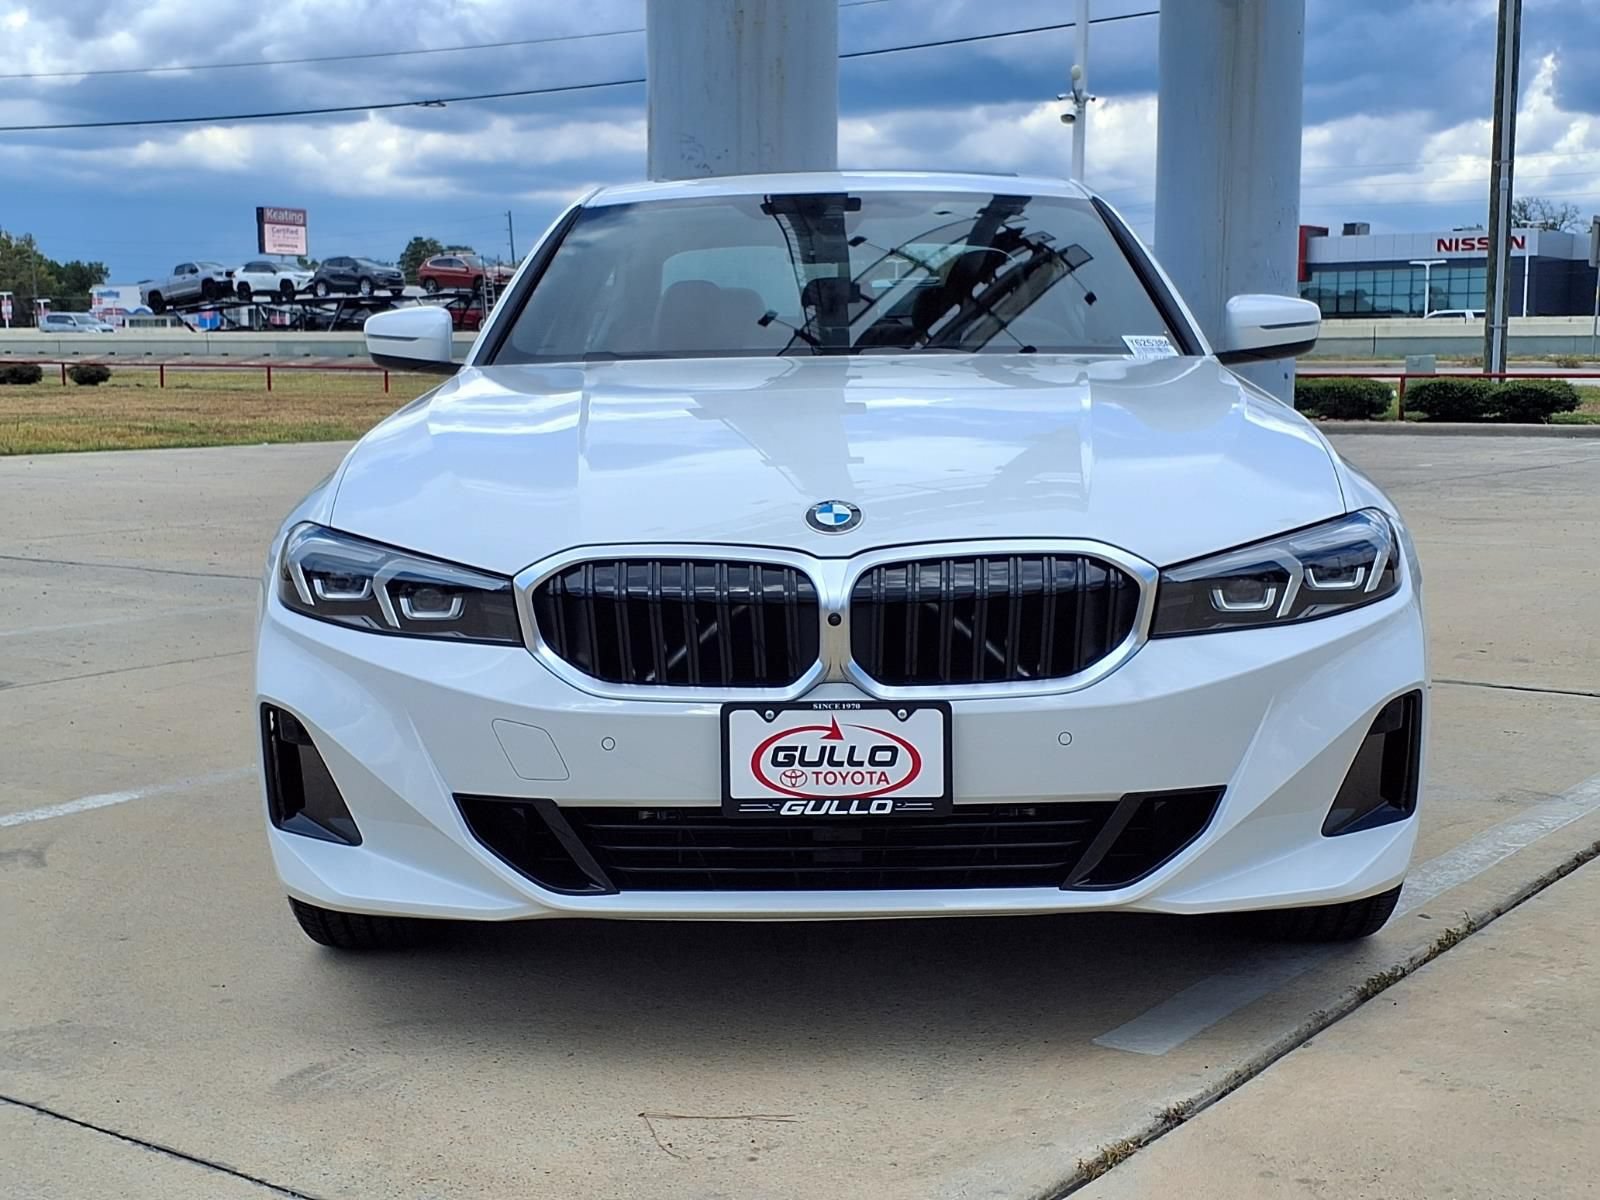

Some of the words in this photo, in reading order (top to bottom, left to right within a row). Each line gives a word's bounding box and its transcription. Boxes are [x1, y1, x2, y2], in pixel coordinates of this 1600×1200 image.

[266, 208, 304, 225] Keating
[1437, 236, 1525, 252] NISSN
[770, 745, 899, 768] GULLO
[811, 770, 890, 786] TOYOTA
[779, 800, 894, 816] GULLO
